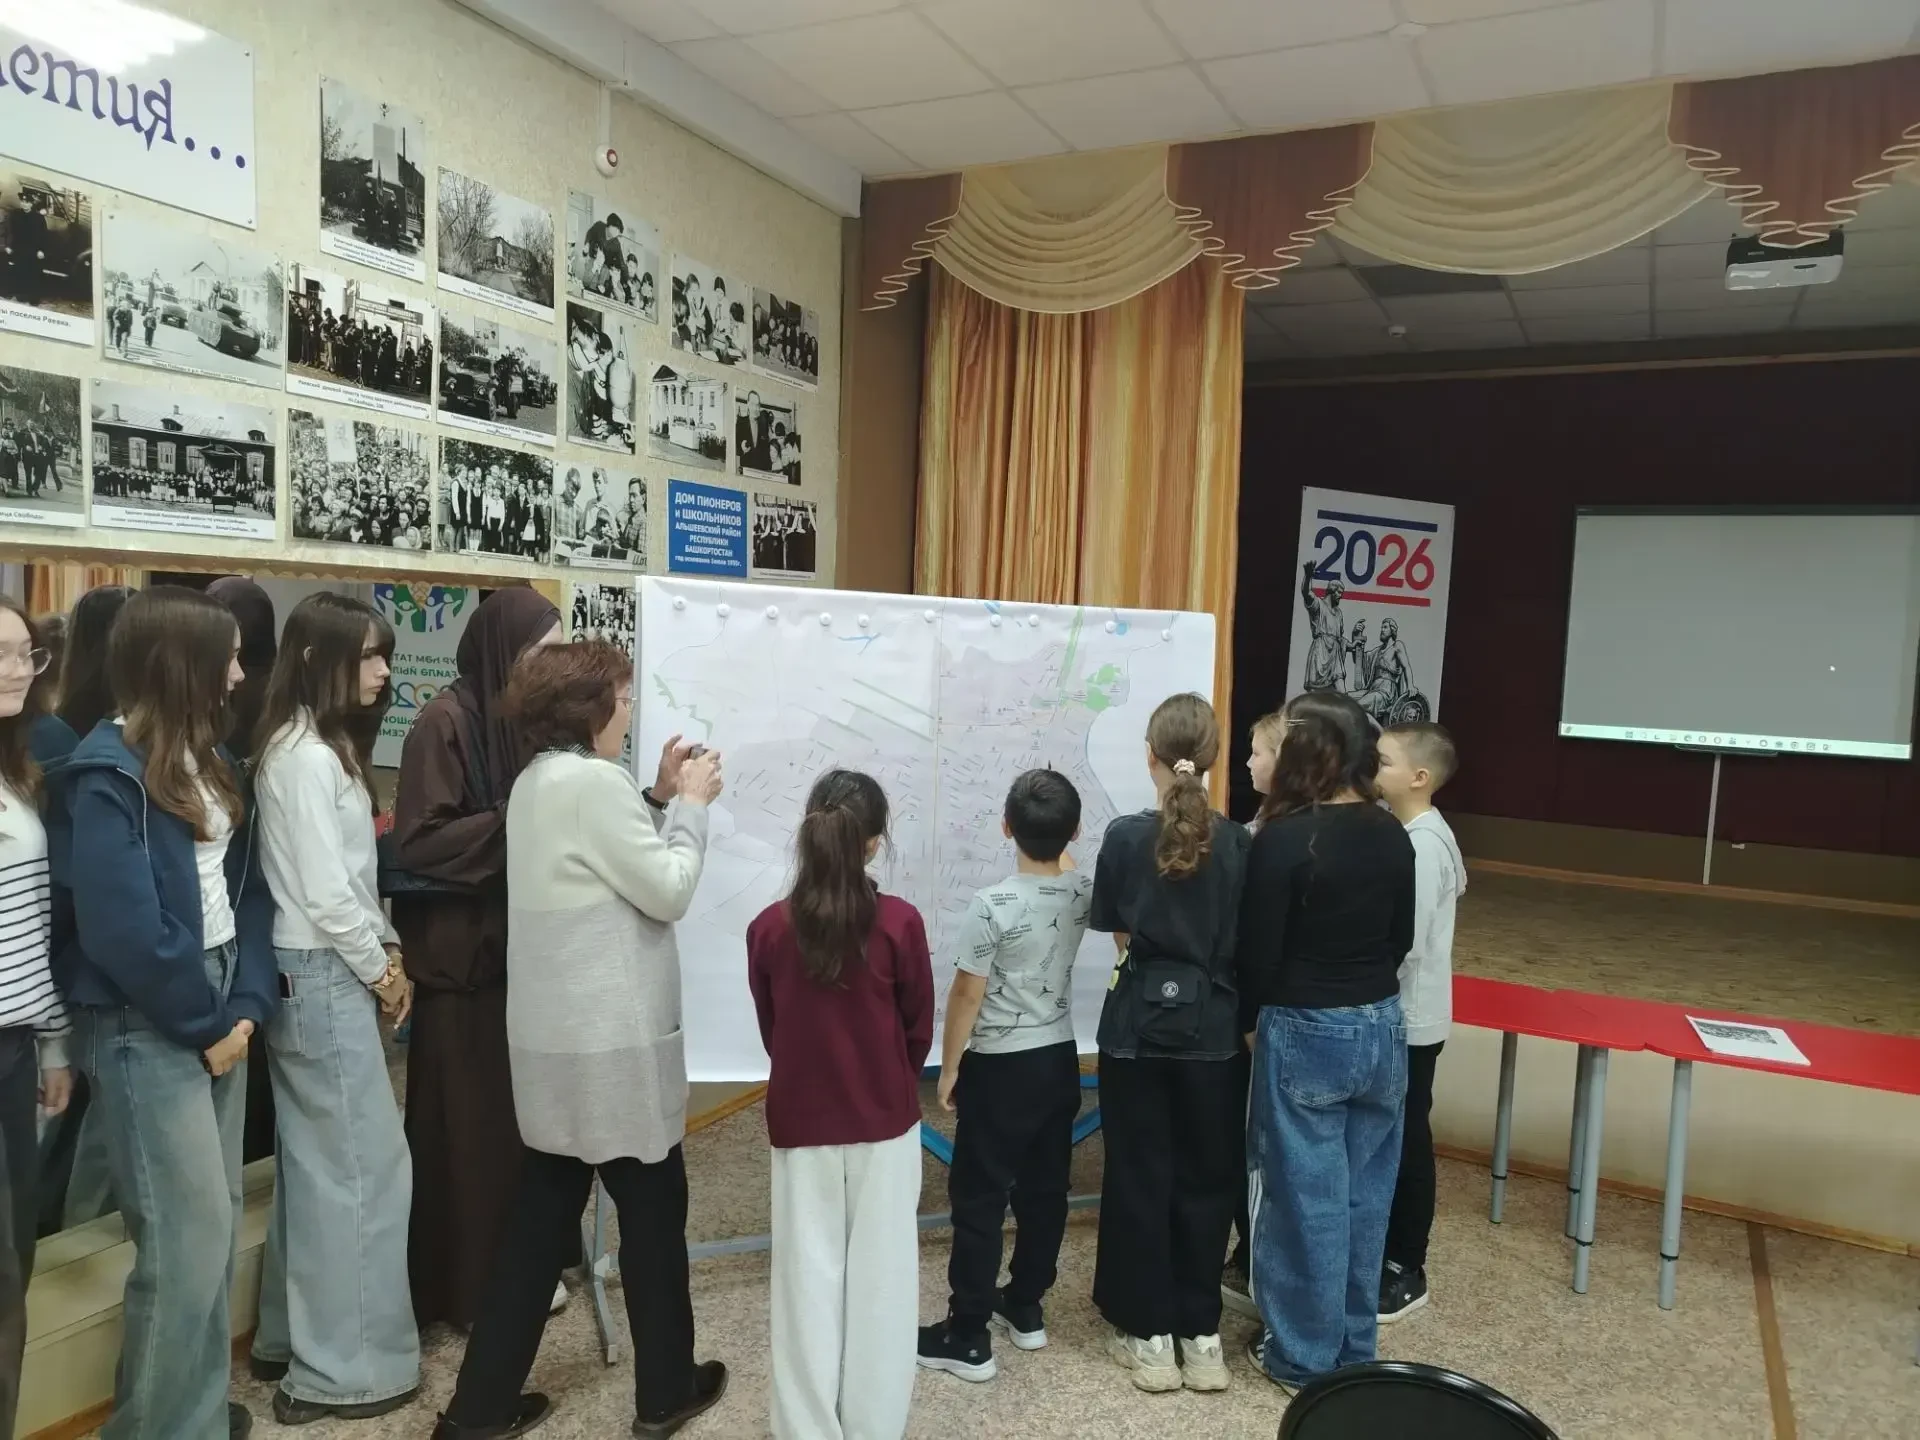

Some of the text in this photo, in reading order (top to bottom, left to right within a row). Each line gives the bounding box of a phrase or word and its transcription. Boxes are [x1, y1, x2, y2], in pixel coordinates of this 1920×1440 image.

[0, 44, 245, 168] етия...
[674, 492, 742, 512] ДОМ ПИОНЕРОВ
[682, 508, 742, 526] ШКОЛЬНИКОВ
[675, 522, 742, 538] АЛЬШЕЕВСКИЙ РАЙОН
[689, 534, 729, 546] РЕСПУБЛИКИ
[684, 544, 733, 557] БАШКОРТОСТАН
[1312, 526, 1435, 592] 2026
